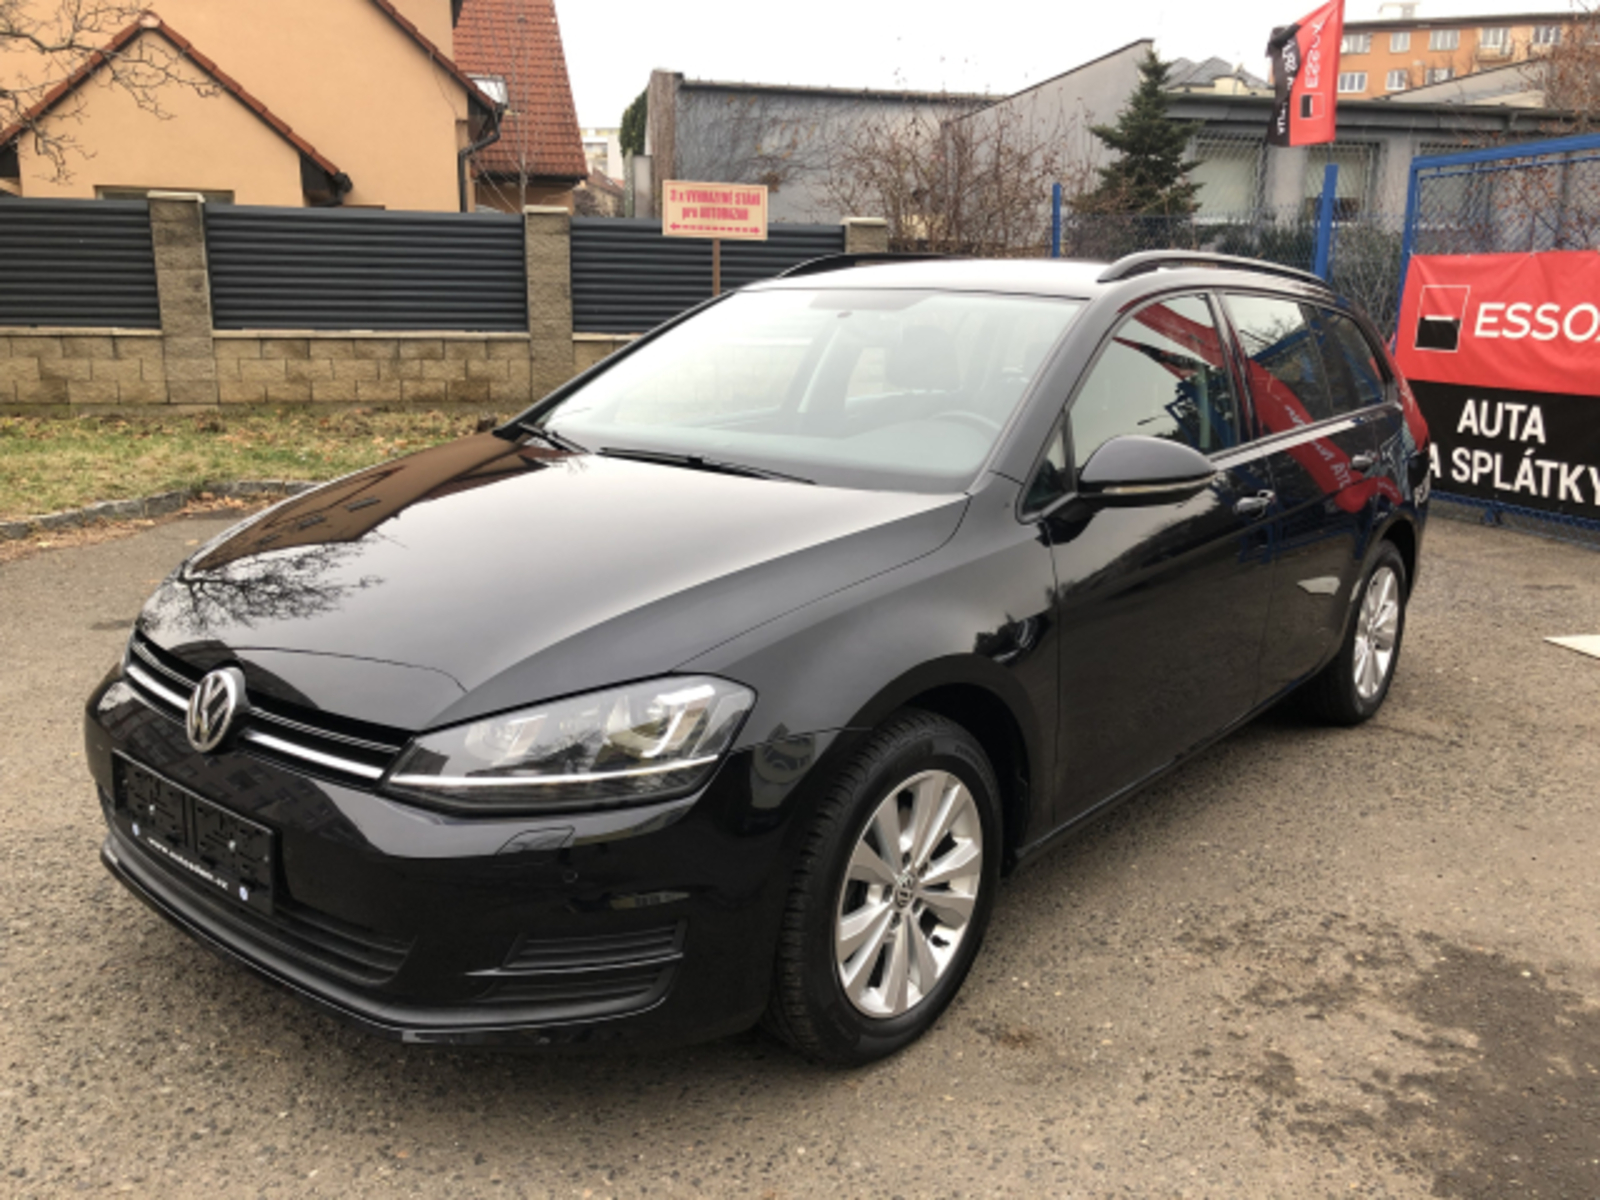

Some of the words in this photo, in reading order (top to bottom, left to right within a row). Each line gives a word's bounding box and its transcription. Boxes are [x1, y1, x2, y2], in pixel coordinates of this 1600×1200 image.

[1474, 302, 1600, 343] ESSO
[1457, 399, 1546, 443] AUTA
[1451, 447, 1600, 506] SPLÁTKY
